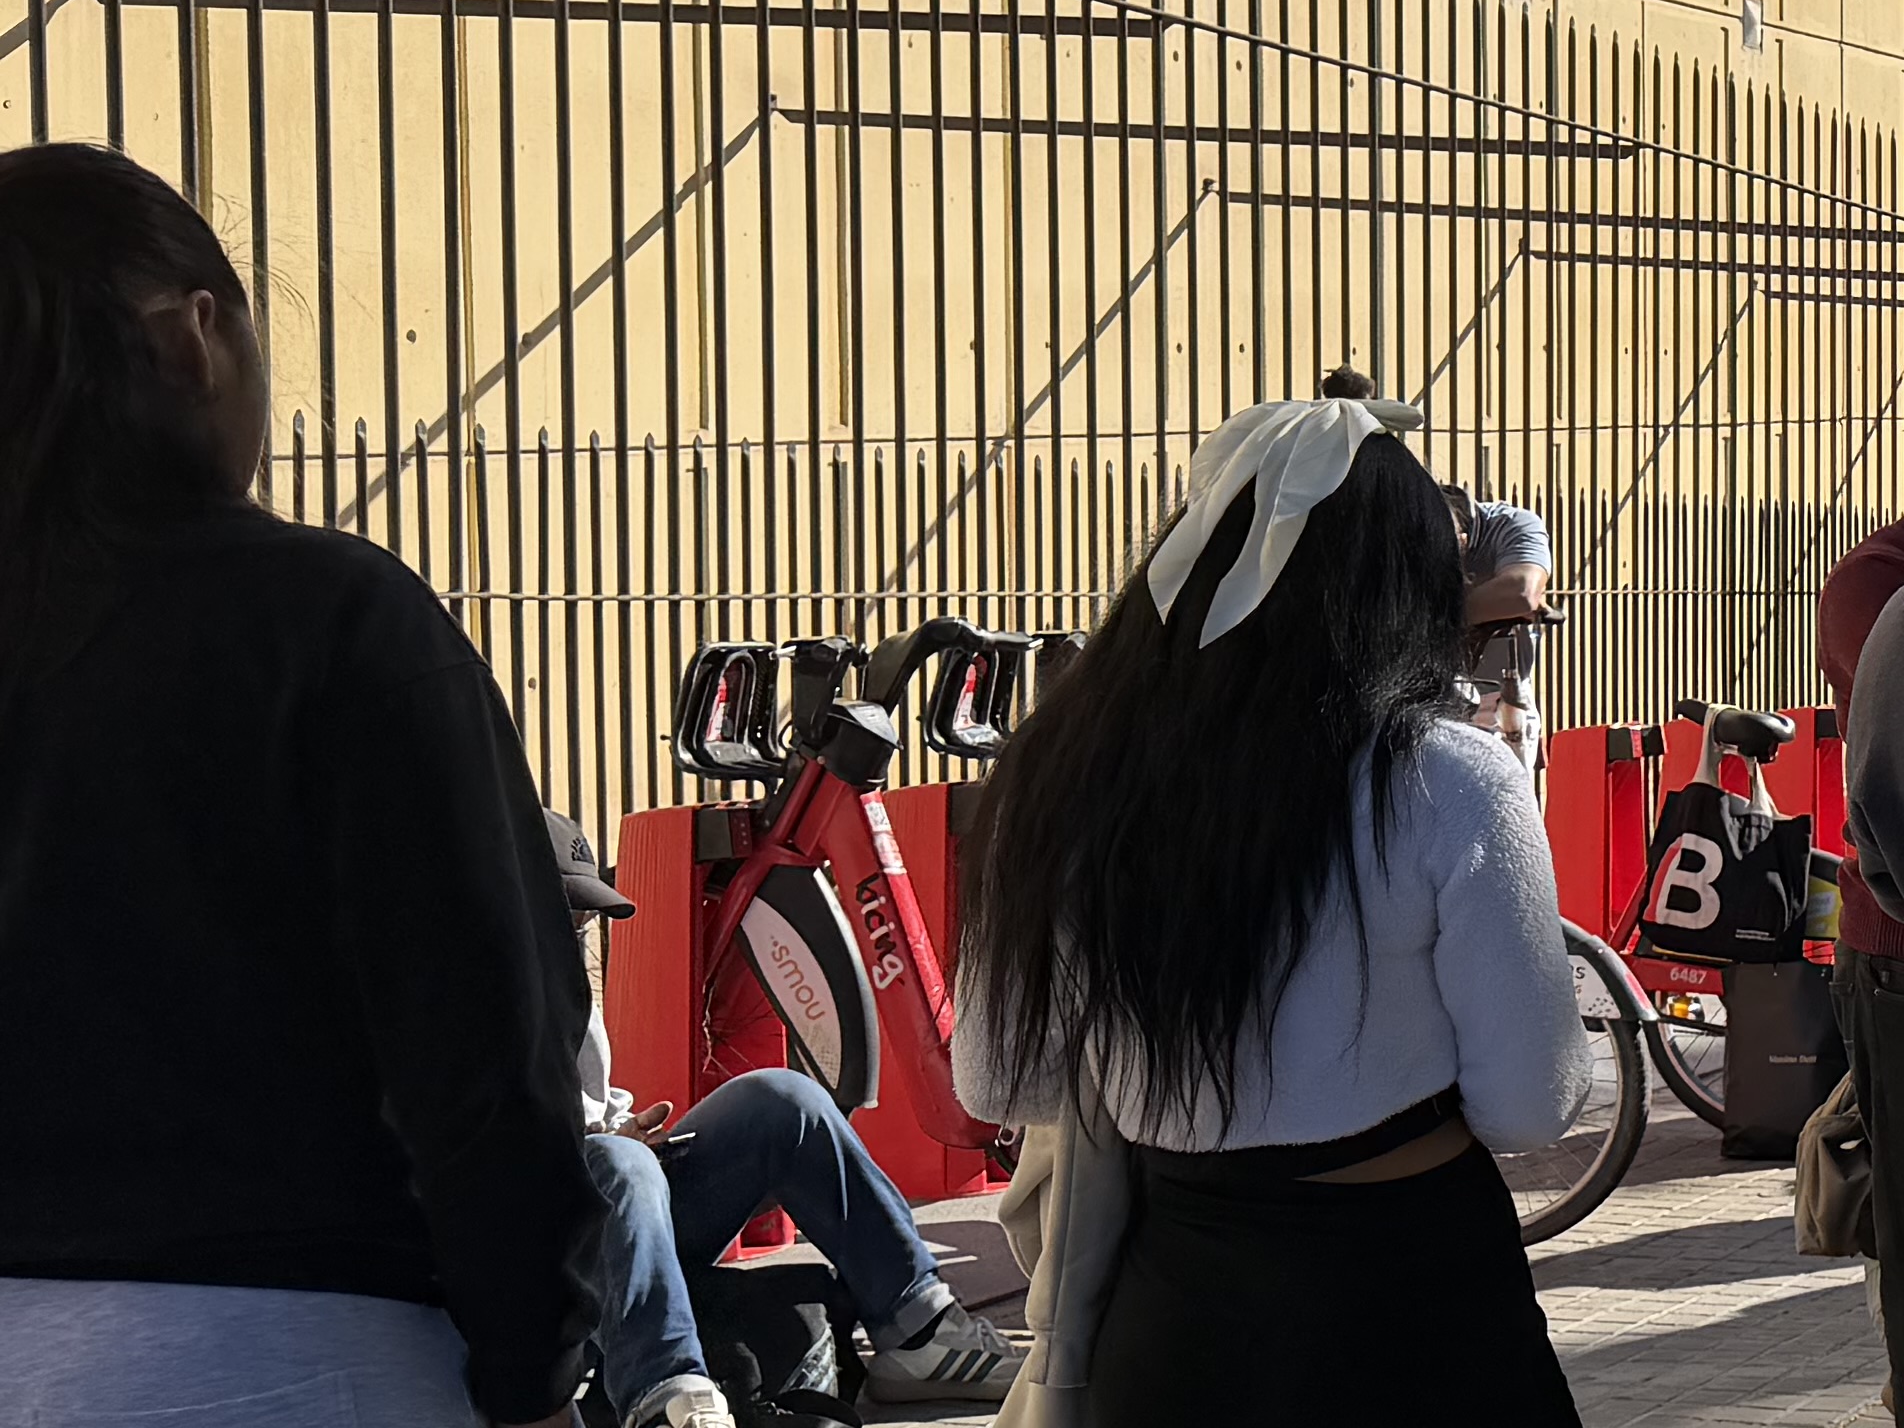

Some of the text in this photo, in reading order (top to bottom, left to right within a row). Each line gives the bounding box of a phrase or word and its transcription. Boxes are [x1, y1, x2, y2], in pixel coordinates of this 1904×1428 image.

[1652, 832, 1723, 930] B
[856, 873, 904, 989] bicing
[771, 945, 826, 1021] smou
[1669, 966, 1707, 984] 6487
